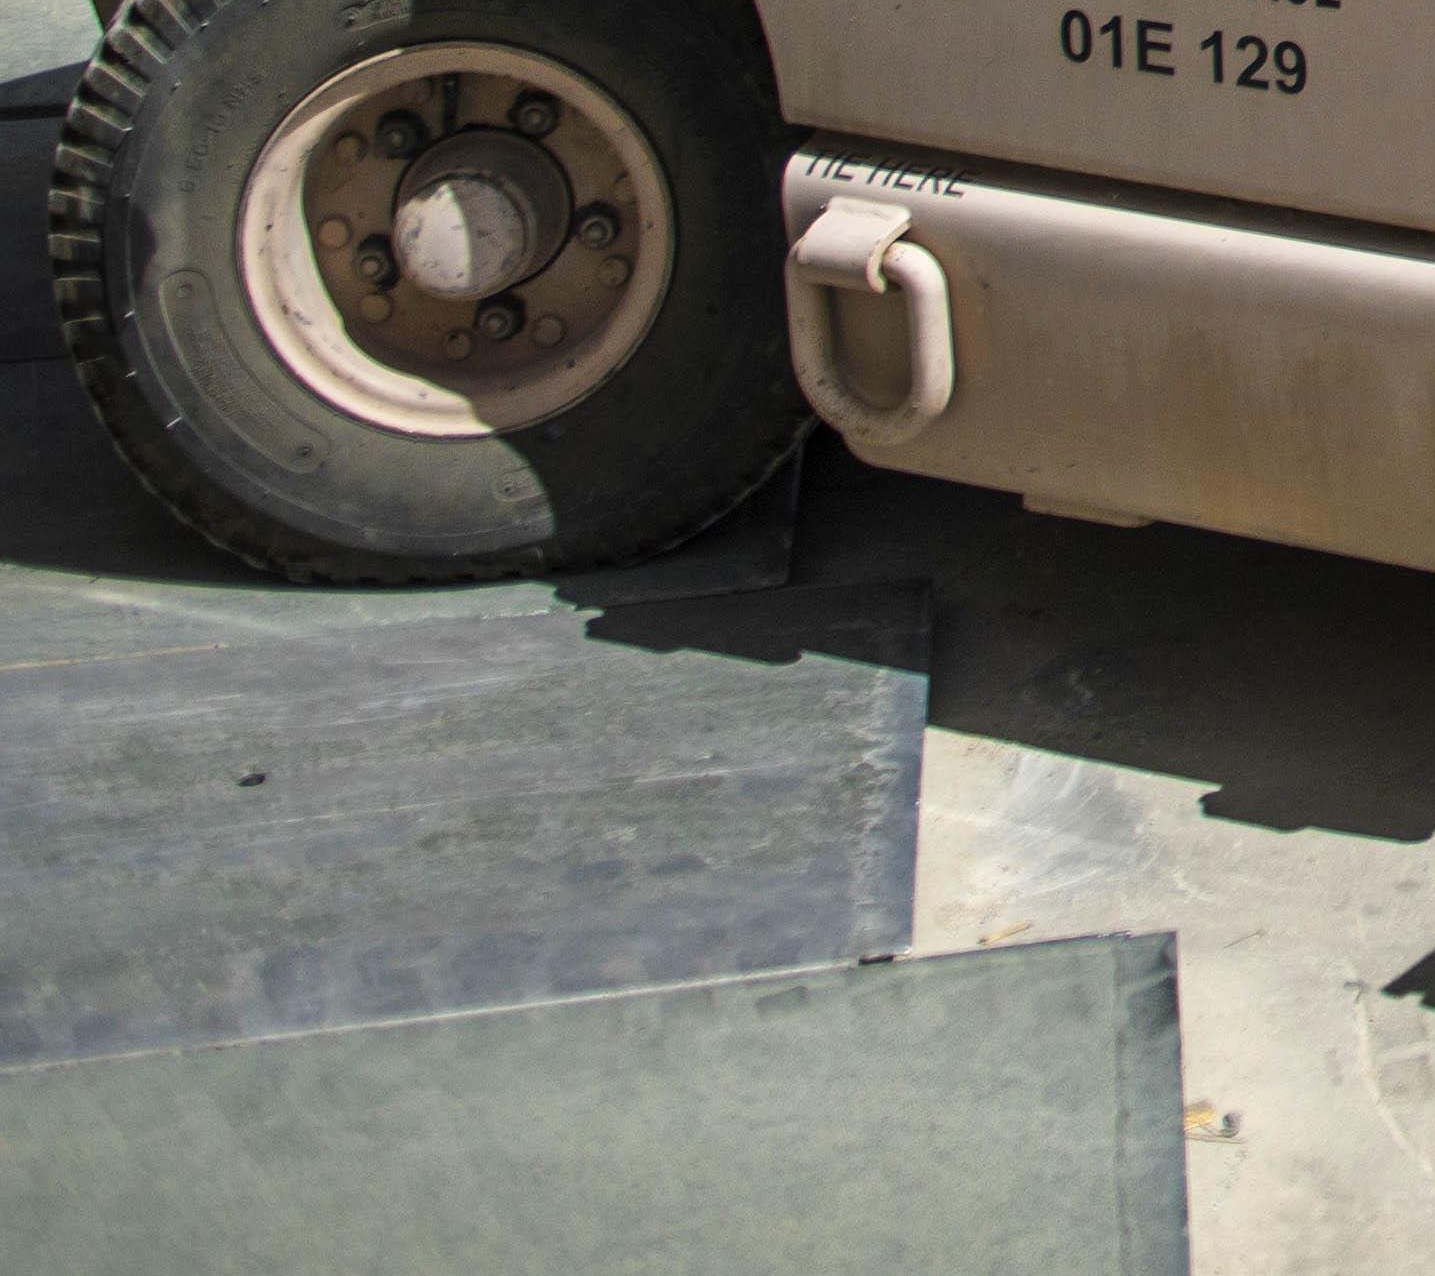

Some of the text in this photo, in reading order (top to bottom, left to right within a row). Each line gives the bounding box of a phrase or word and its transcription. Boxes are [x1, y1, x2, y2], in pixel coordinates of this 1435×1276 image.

[1061, 9, 1307, 96] 01E 129
[805, 152, 984, 199] TIE HERE
